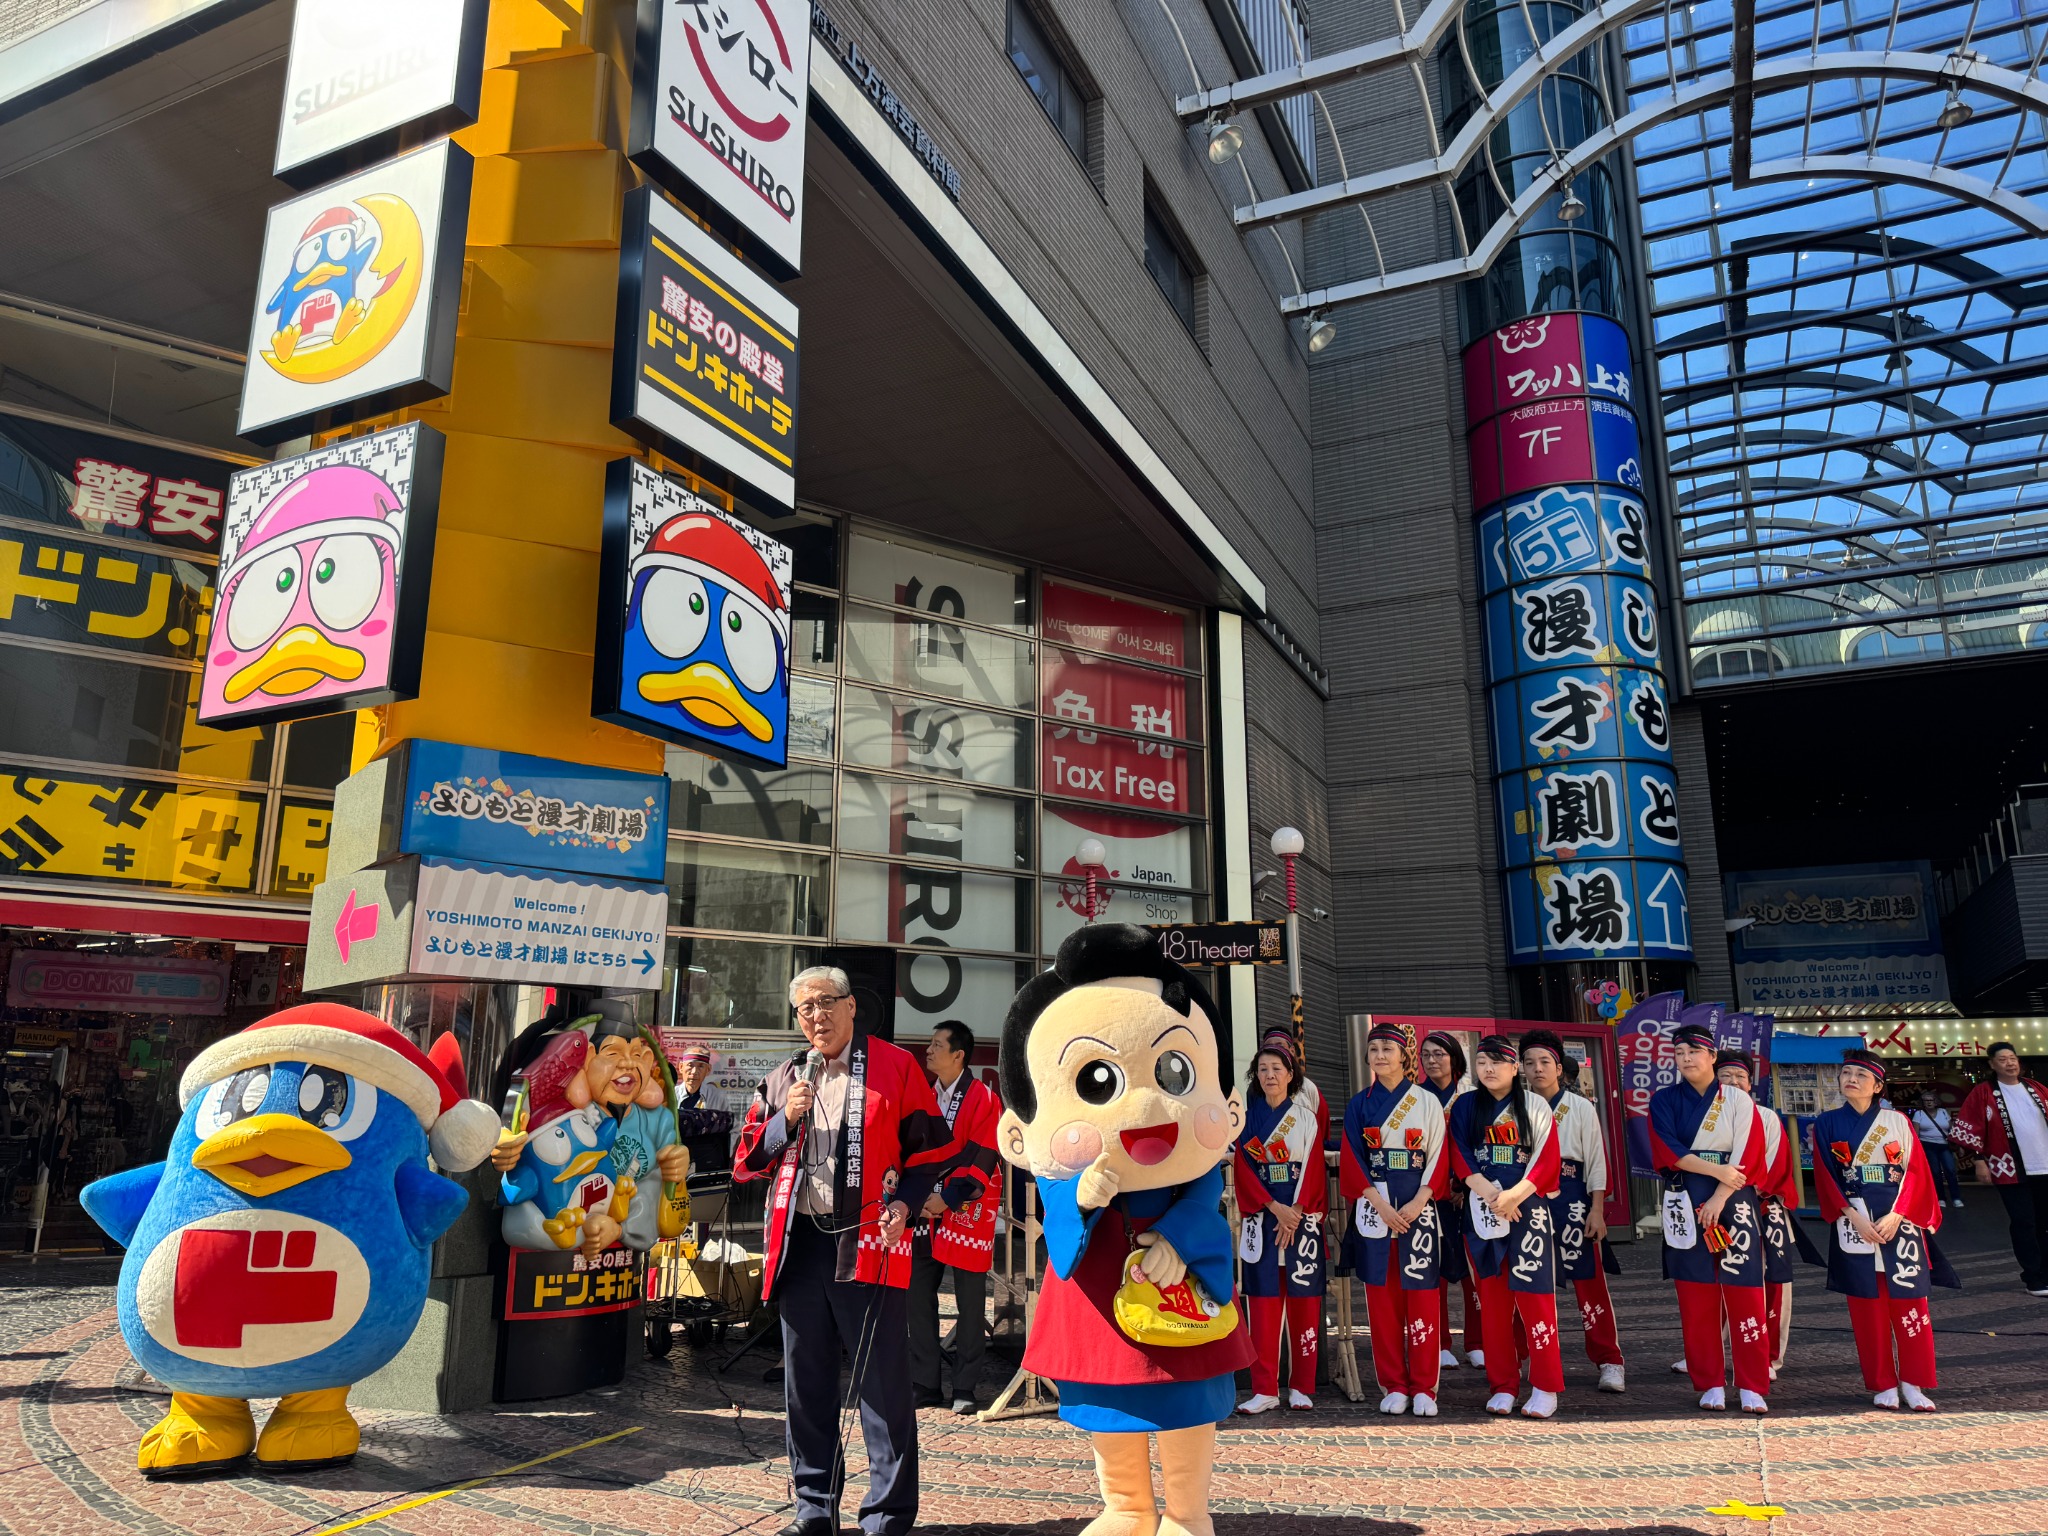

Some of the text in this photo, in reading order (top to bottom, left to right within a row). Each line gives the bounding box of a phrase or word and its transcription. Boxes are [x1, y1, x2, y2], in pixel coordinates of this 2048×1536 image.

[667, 86, 796, 219] SUSHIRO
[661, 275, 784, 395] 驚安の殿堂
[1518, 426, 1562, 458] 7F
[70, 458, 224, 543] 驚安
[1519, 515, 1591, 575] 5F
[1046, 617, 1110, 641] WELCOME
[1117, 632, 1140, 650] 어서
[1617, 504, 1679, 846] よしもと
[1052, 755, 1176, 803] Tax Free
[1526, 588, 1625, 946] 漫才劇場
[433, 788, 645, 838] よしもと漫才劇場
[1131, 865, 1177, 884] Japan.
[426, 910, 523, 931] YOSHIMOTO
[527, 920, 587, 937] MANZAI
[1145, 904, 1178, 923] Shop
[425, 936, 627, 968] よしもと漫才劇場 はこちら
[1187, 939, 1255, 960] Theater
[44, 969, 134, 994] DONKI
[1744, 975, 1817, 986] YOSHIMOTO
[1821, 973, 1871, 984] MANZAI
[739, 1056, 768, 1068] ecbo
[1924, 1041, 1987, 1057] ヨシモト
[720, 1076, 756, 1089] ecbo
[1628, 1019, 1658, 1117] Comedy
[1954, 1119, 1974, 1131] 2025
[1403, 1203, 1436, 1280] まいど
[1512, 1206, 1548, 1283] まいど
[1720, 1200, 1752, 1276] まいど
[1765, 1201, 1785, 1258] まい
